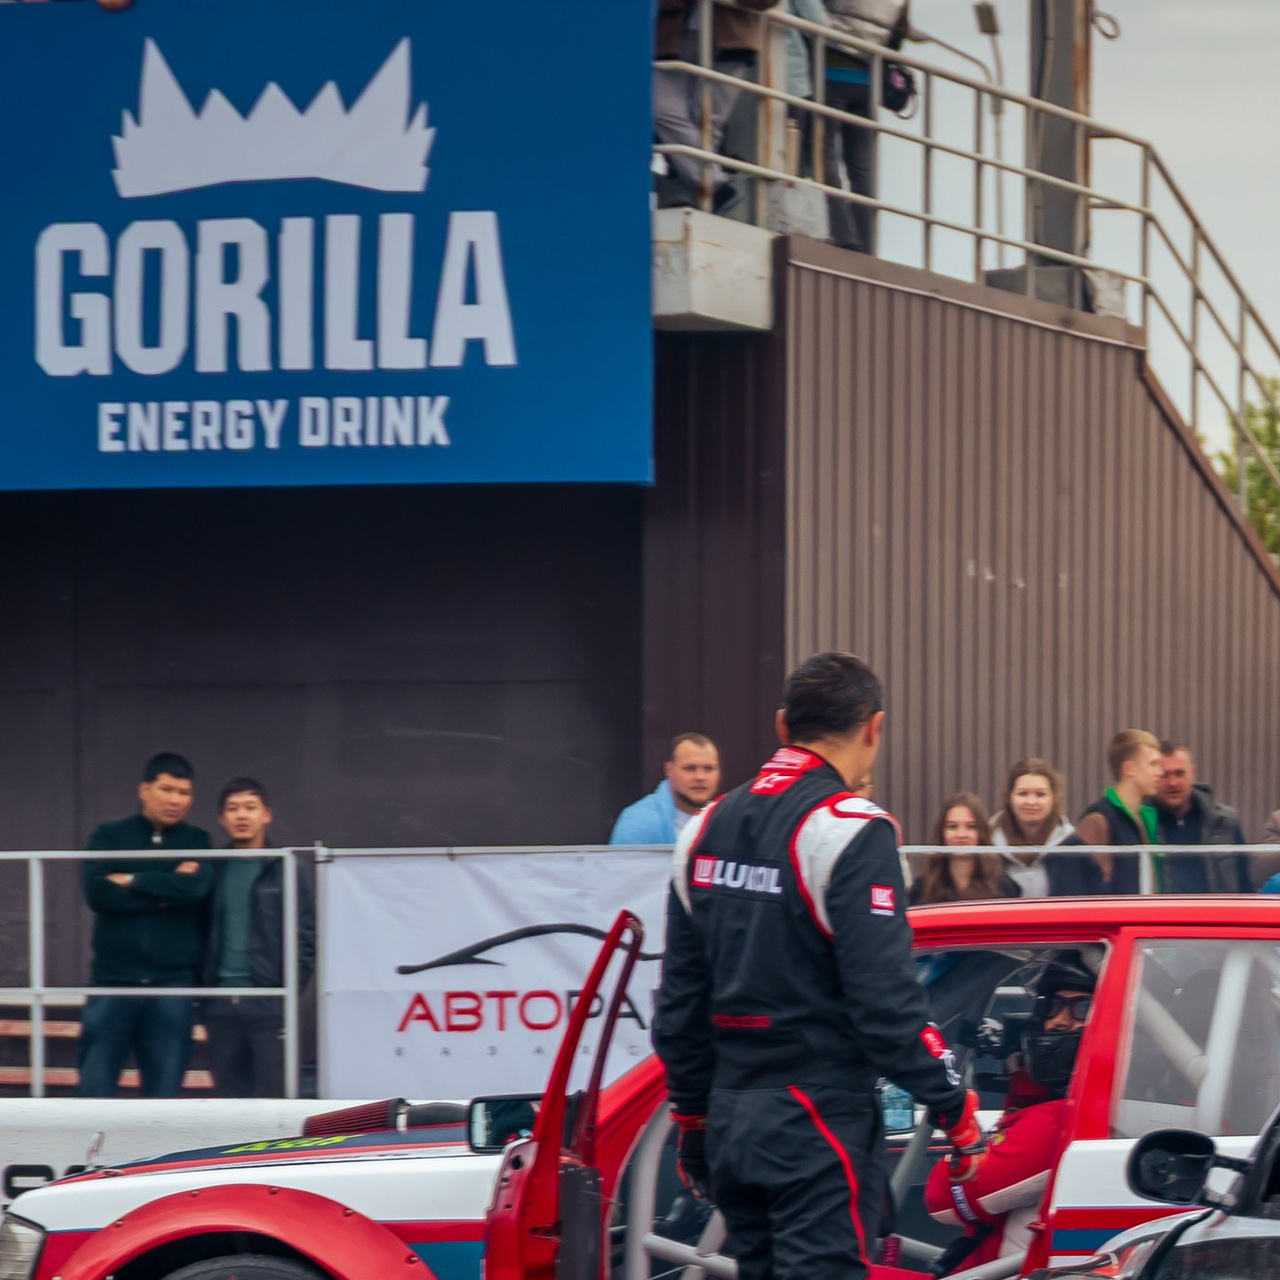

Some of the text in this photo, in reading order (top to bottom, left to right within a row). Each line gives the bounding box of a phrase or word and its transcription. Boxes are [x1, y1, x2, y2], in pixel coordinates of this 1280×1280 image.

[35, 210, 517, 377] GORILLA
[98, 395, 451, 452] ENERGY DRINK
